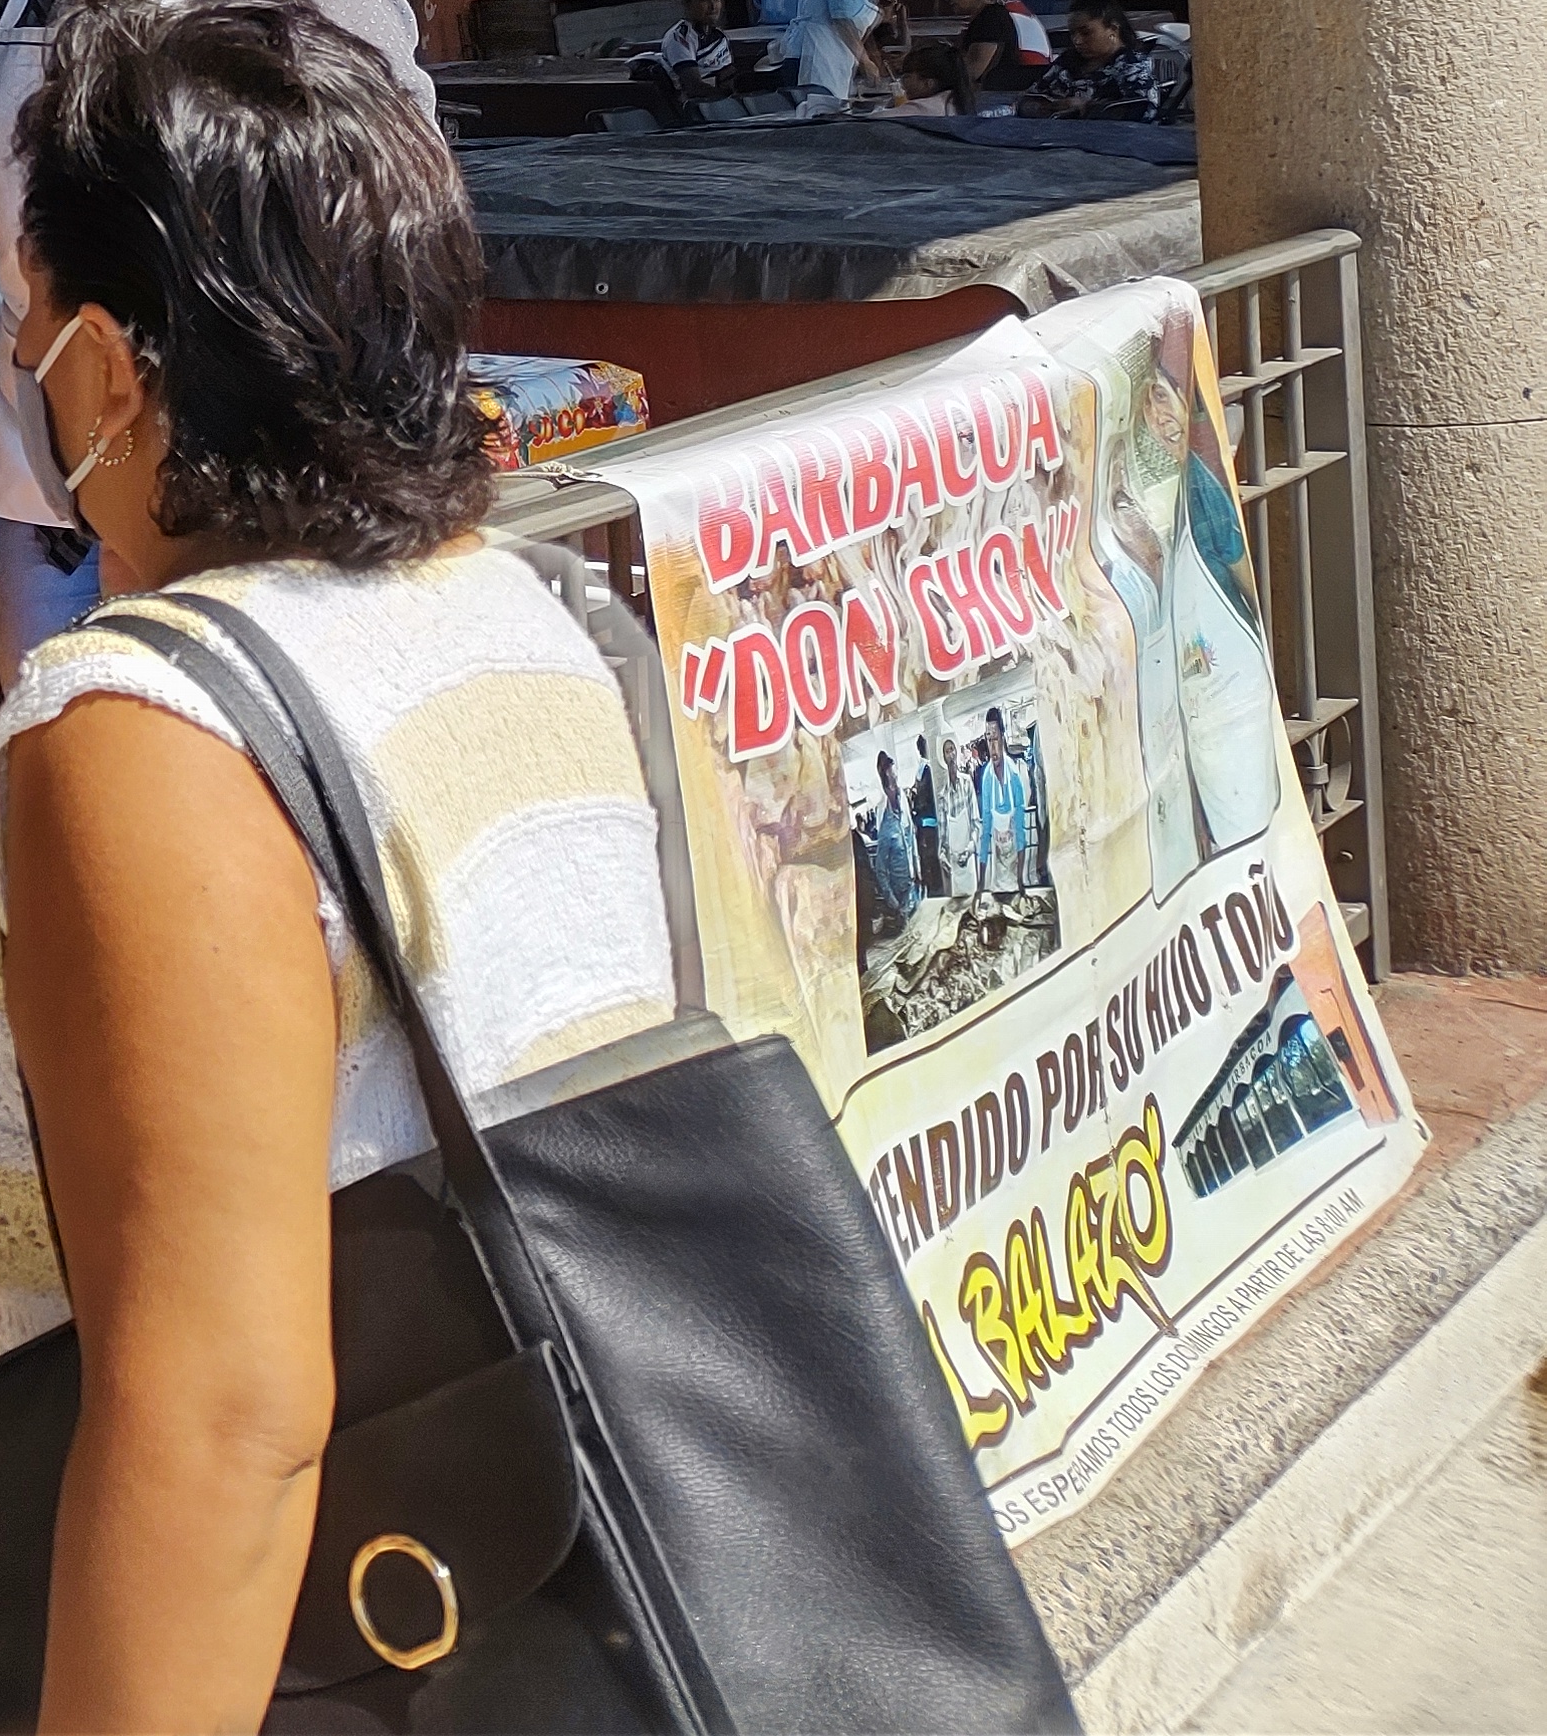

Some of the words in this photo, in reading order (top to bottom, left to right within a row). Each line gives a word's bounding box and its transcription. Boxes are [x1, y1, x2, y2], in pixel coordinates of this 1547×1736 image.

[697, 368, 1061, 587] BARBACOA
[1036, 1016, 1107, 1153] POR
[1106, 975, 1145, 1092] SU
[1025, 1427, 1120, 1516] ESPERAMOS
[1110, 1386, 1158, 1443] TODOS
[1153, 1361, 1182, 1400] LOS
[1174, 1306, 1240, 1375] DOMINGOS
[1239, 1255, 1289, 1309] PARTIR
[1282, 1243, 1306, 1273] DE
[1302, 1224, 1326, 1259] LAS
